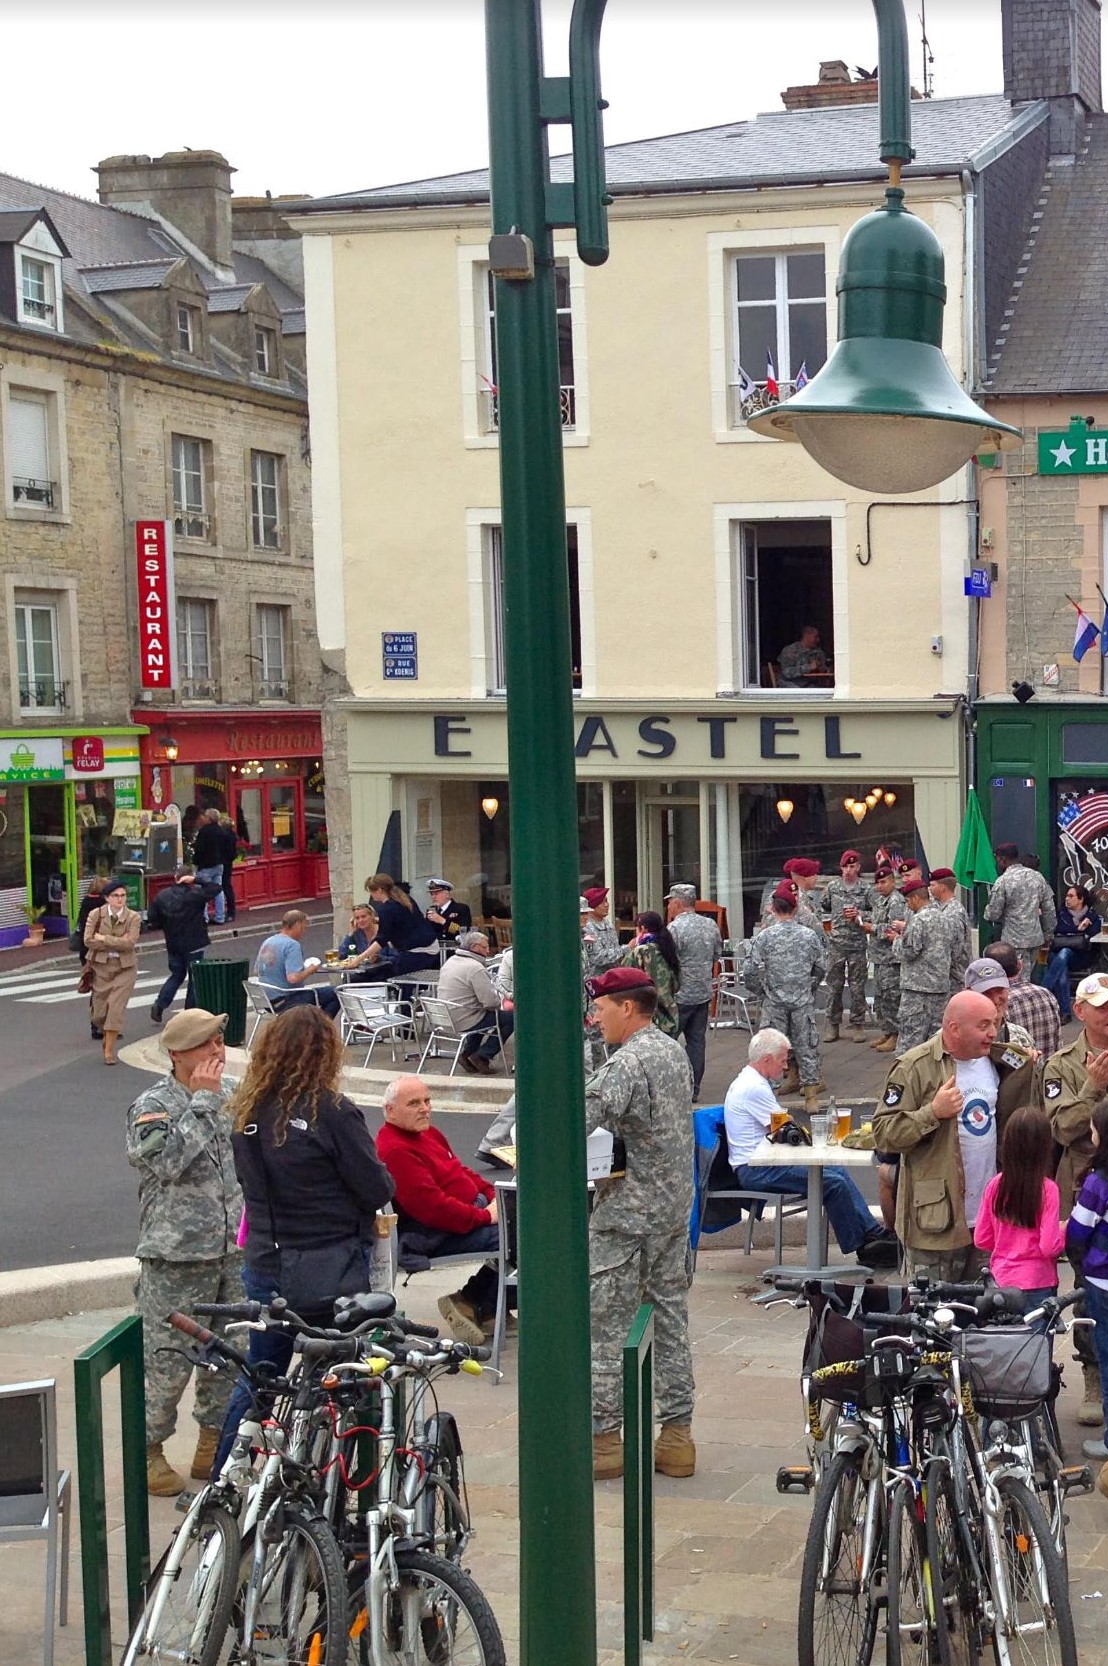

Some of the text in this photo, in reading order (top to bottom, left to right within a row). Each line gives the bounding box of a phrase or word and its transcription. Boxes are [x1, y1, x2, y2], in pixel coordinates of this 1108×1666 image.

[143, 527, 164, 682] RESTAURANT
[393, 644, 399, 653] 6
[400, 644, 414, 652] JUIN
